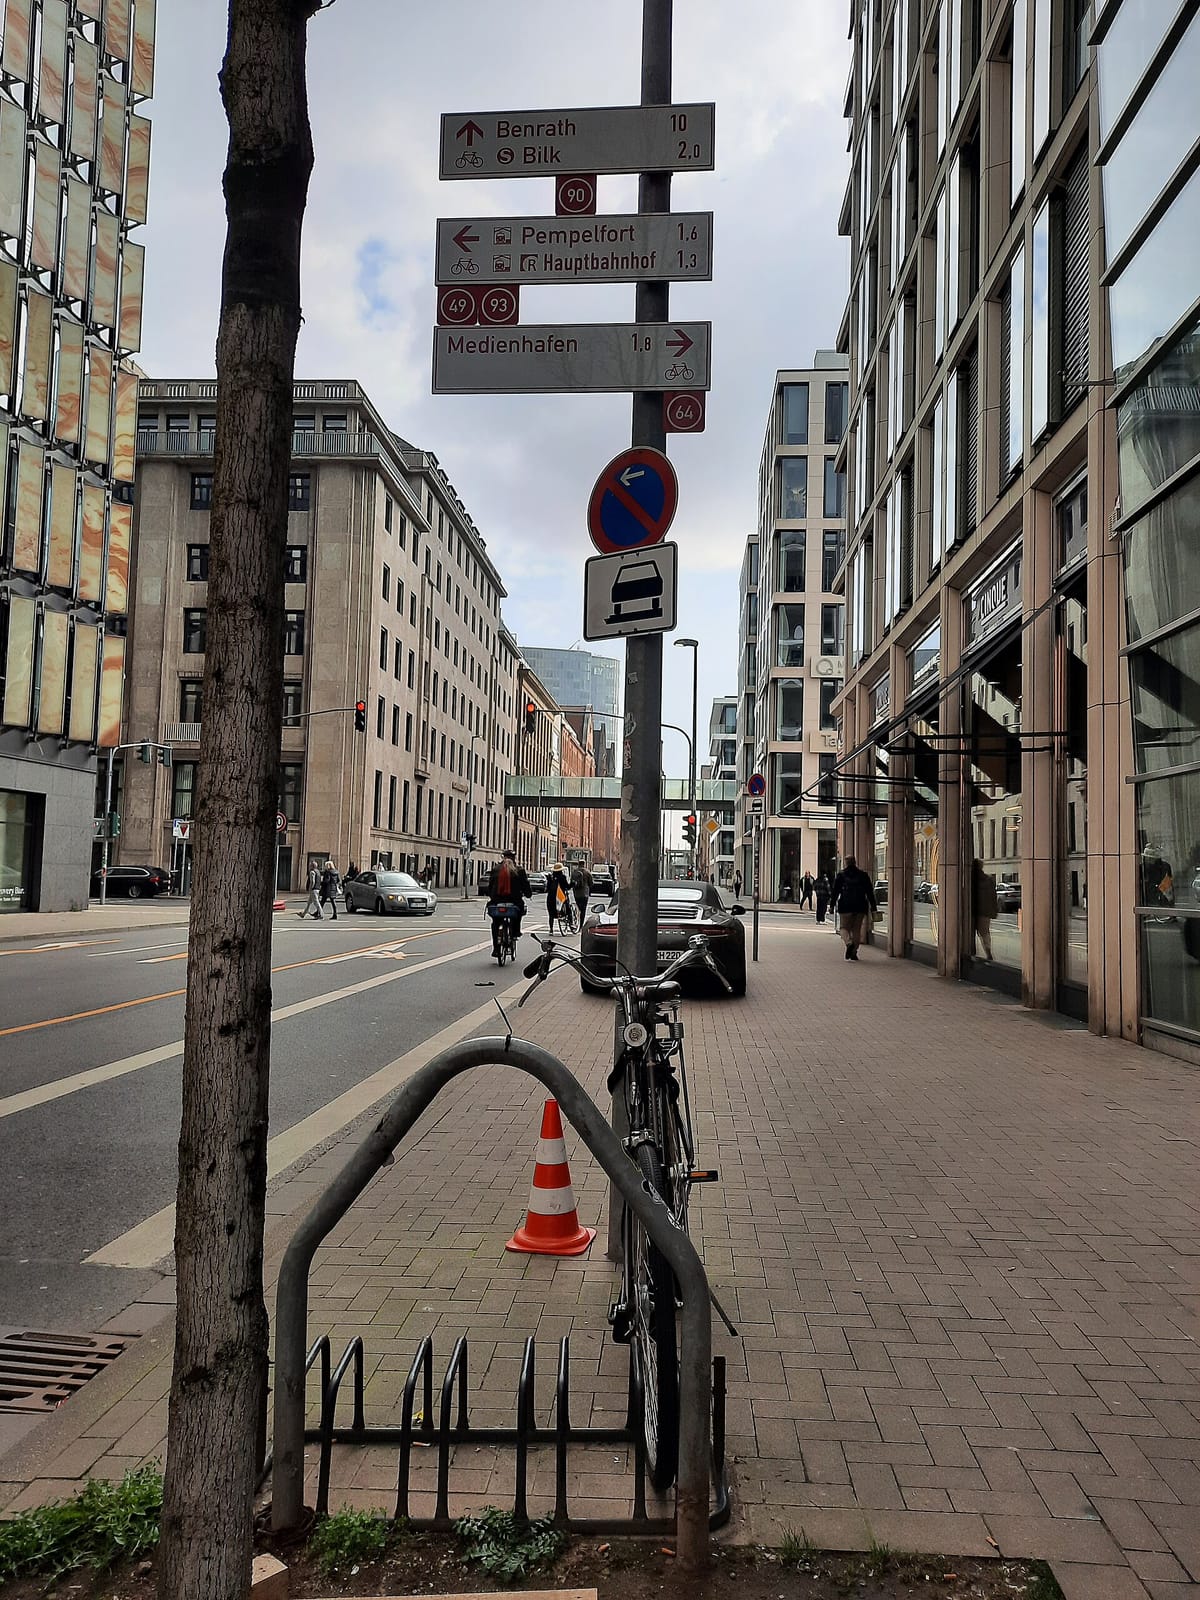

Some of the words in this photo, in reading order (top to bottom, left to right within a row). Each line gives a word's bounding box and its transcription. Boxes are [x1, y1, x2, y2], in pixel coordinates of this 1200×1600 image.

[497, 119, 576, 138] Benrath
[671, 113, 687, 132] 10
[523, 145, 561, 164] Bilk
[678, 140, 700, 159] 2,0
[567, 188, 585, 203] 90
[522, 224, 635, 248] Pempelfort
[677, 222, 698, 242] 1,6
[543, 251, 656, 275] Hauptbahnhof
[677, 250, 697, 269] 1,3
[449, 299, 467, 313] 49
[490, 298, 508, 313] 93
[447, 334, 578, 354] Medienhafen
[631, 333, 652, 352] 1,8
[675, 405, 694, 420] 64
[980, 574, 1007, 620] CINQUE
